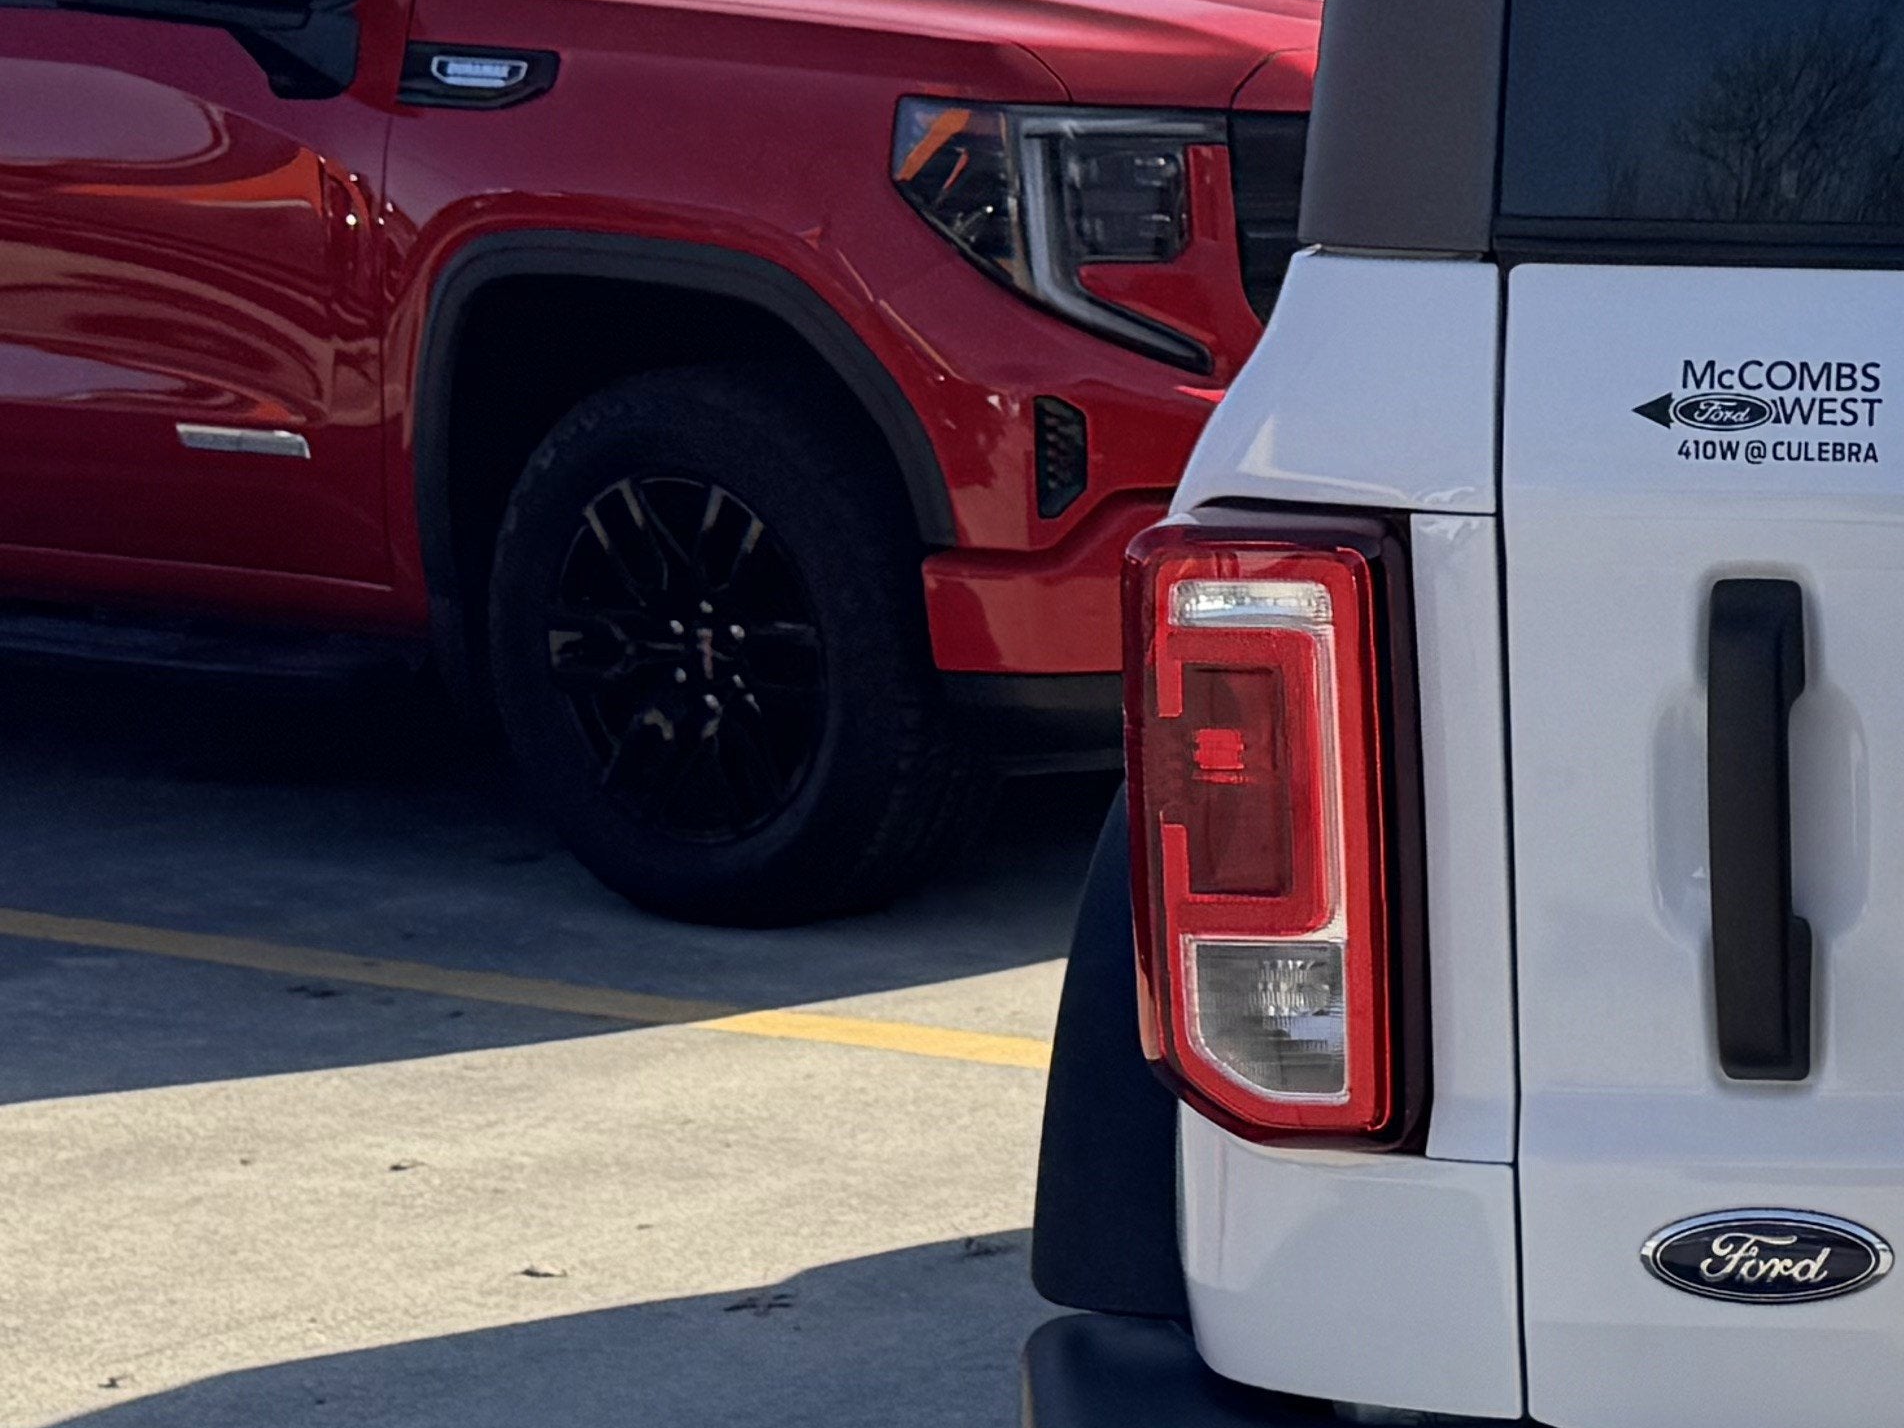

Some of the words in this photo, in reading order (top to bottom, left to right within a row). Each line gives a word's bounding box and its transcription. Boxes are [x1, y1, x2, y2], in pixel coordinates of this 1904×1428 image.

[1682, 359, 1882, 392] McCOMBS
[1694, 400, 1750, 422] Ford
[1780, 397, 1883, 427] WEST
[1678, 440, 1740, 461] 410W
[1745, 440, 1767, 465] @
[1772, 441, 1879, 463] CULEBRA
[1700, 1232, 1832, 1283] Ford
